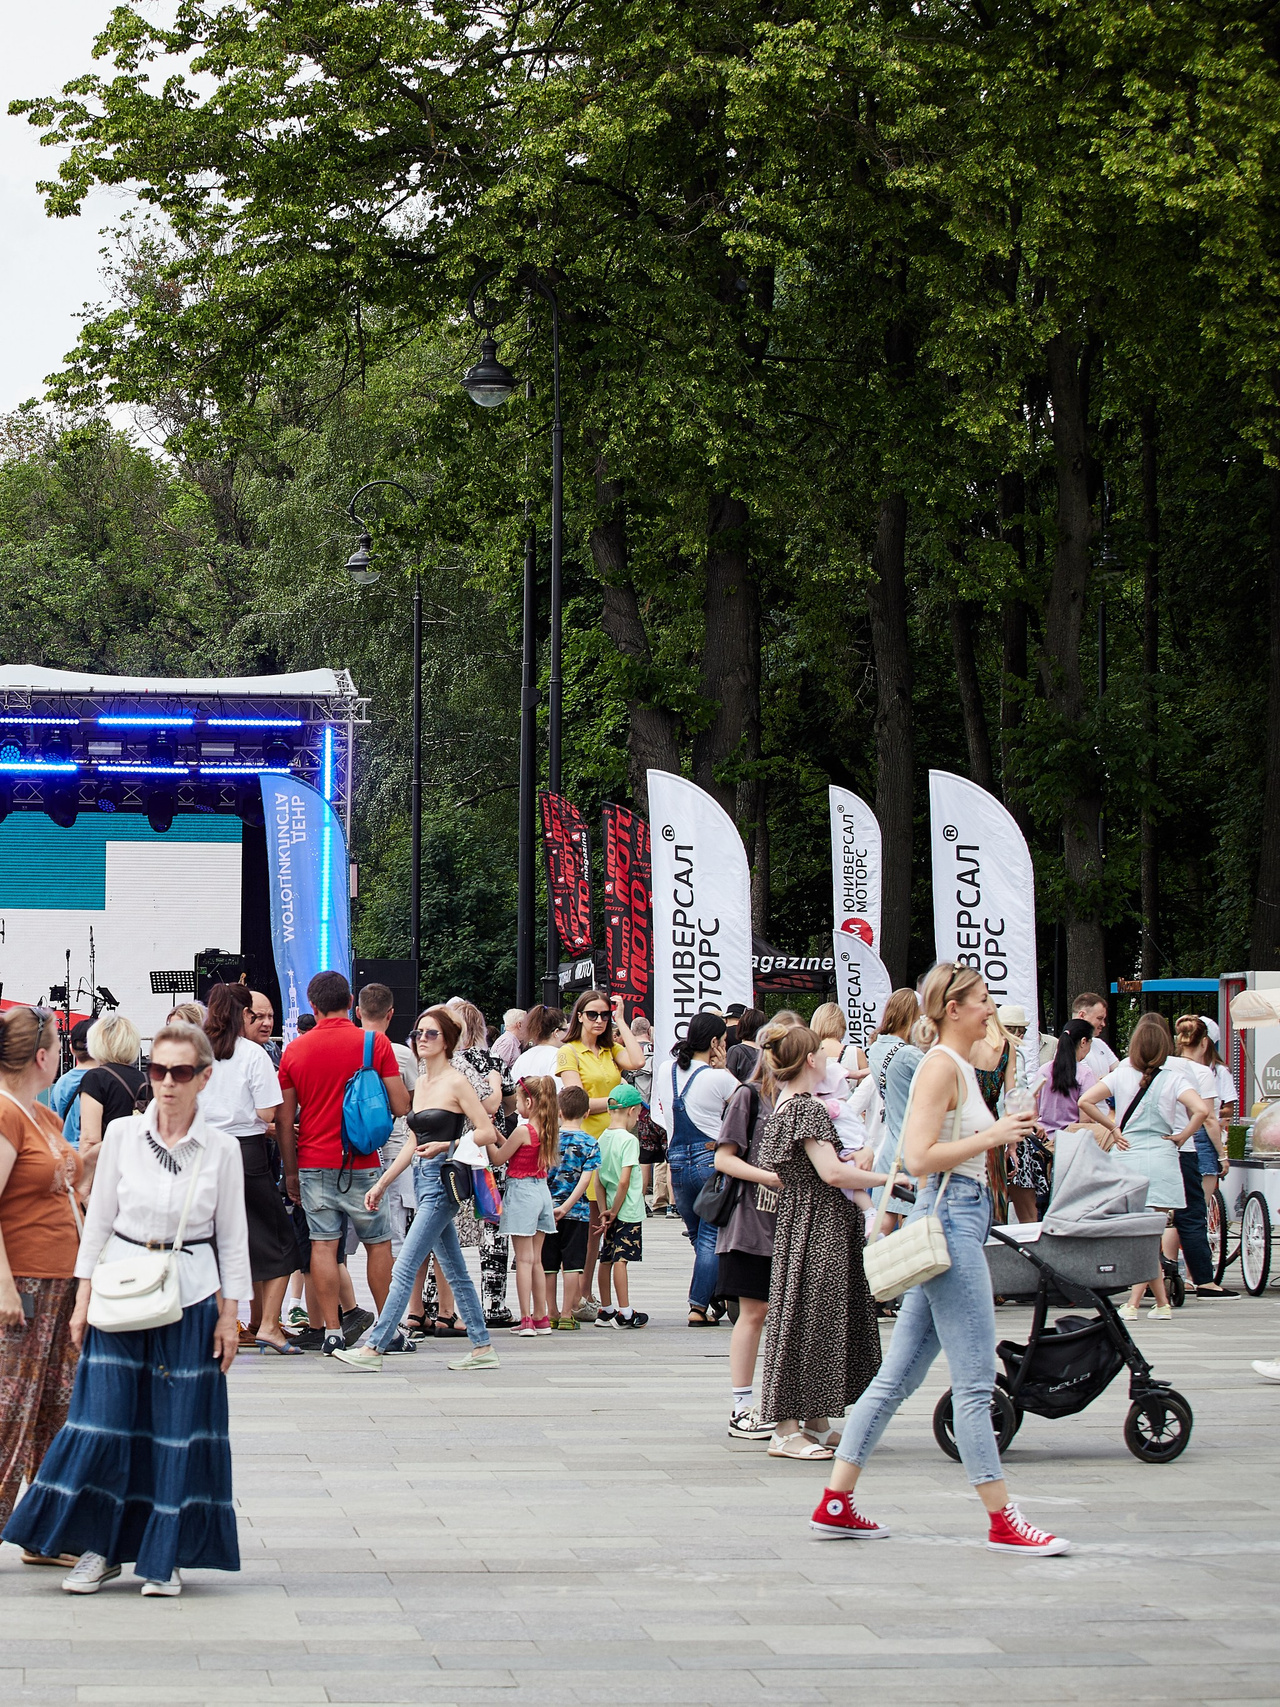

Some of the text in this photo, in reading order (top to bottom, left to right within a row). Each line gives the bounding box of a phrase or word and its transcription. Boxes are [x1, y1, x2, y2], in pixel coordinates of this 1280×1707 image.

[581, 831, 590, 881] magazine
[843, 814, 855, 913] ЮНИВЕРСАЛ
[856, 849, 868, 913] МОТОРС
[631, 880, 648, 994] MOTO
[956, 845, 981, 972] ВЕРСАЛ
[985, 917, 1008, 996] ТОРС
[848, 962, 862, 1050] ИВЕРСАЛ
[882, 1045, 899, 1070] PARIS
